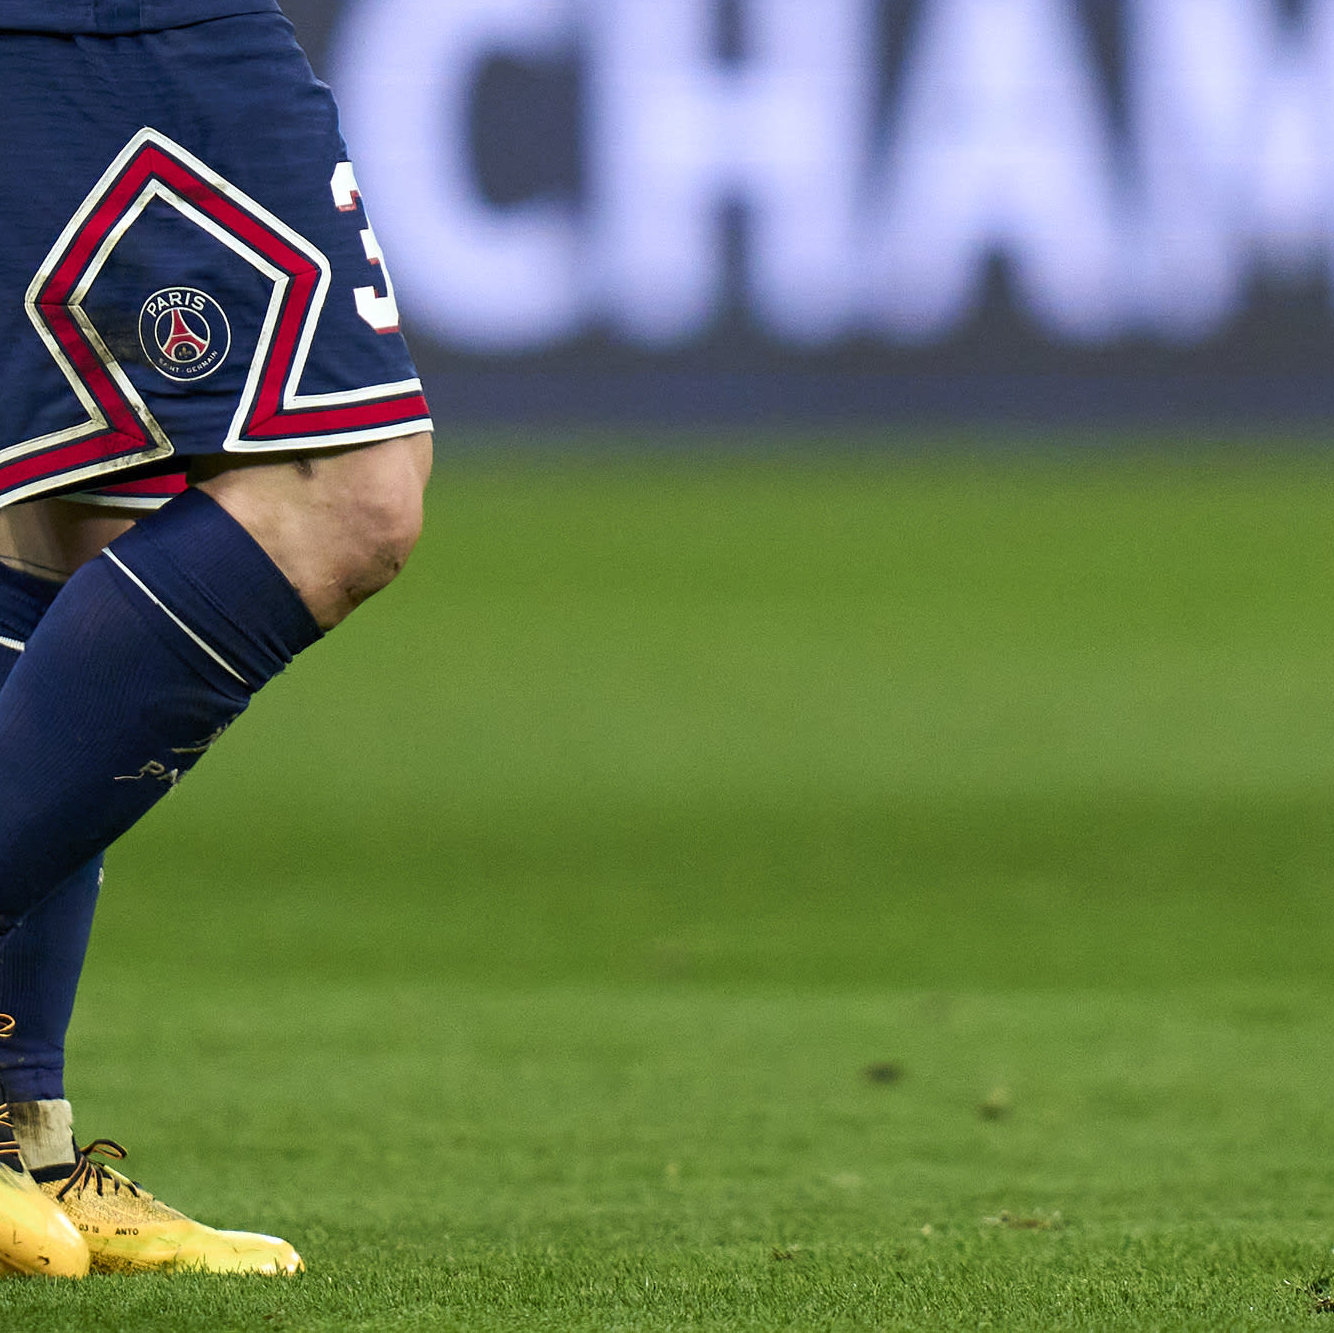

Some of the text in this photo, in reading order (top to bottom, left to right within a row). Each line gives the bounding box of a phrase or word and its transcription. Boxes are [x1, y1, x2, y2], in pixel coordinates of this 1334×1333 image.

[146, 291, 207, 318] PARIS
[186, 350, 218, 374] GERMAIN
[114, 1227, 139, 1236] ANTO
